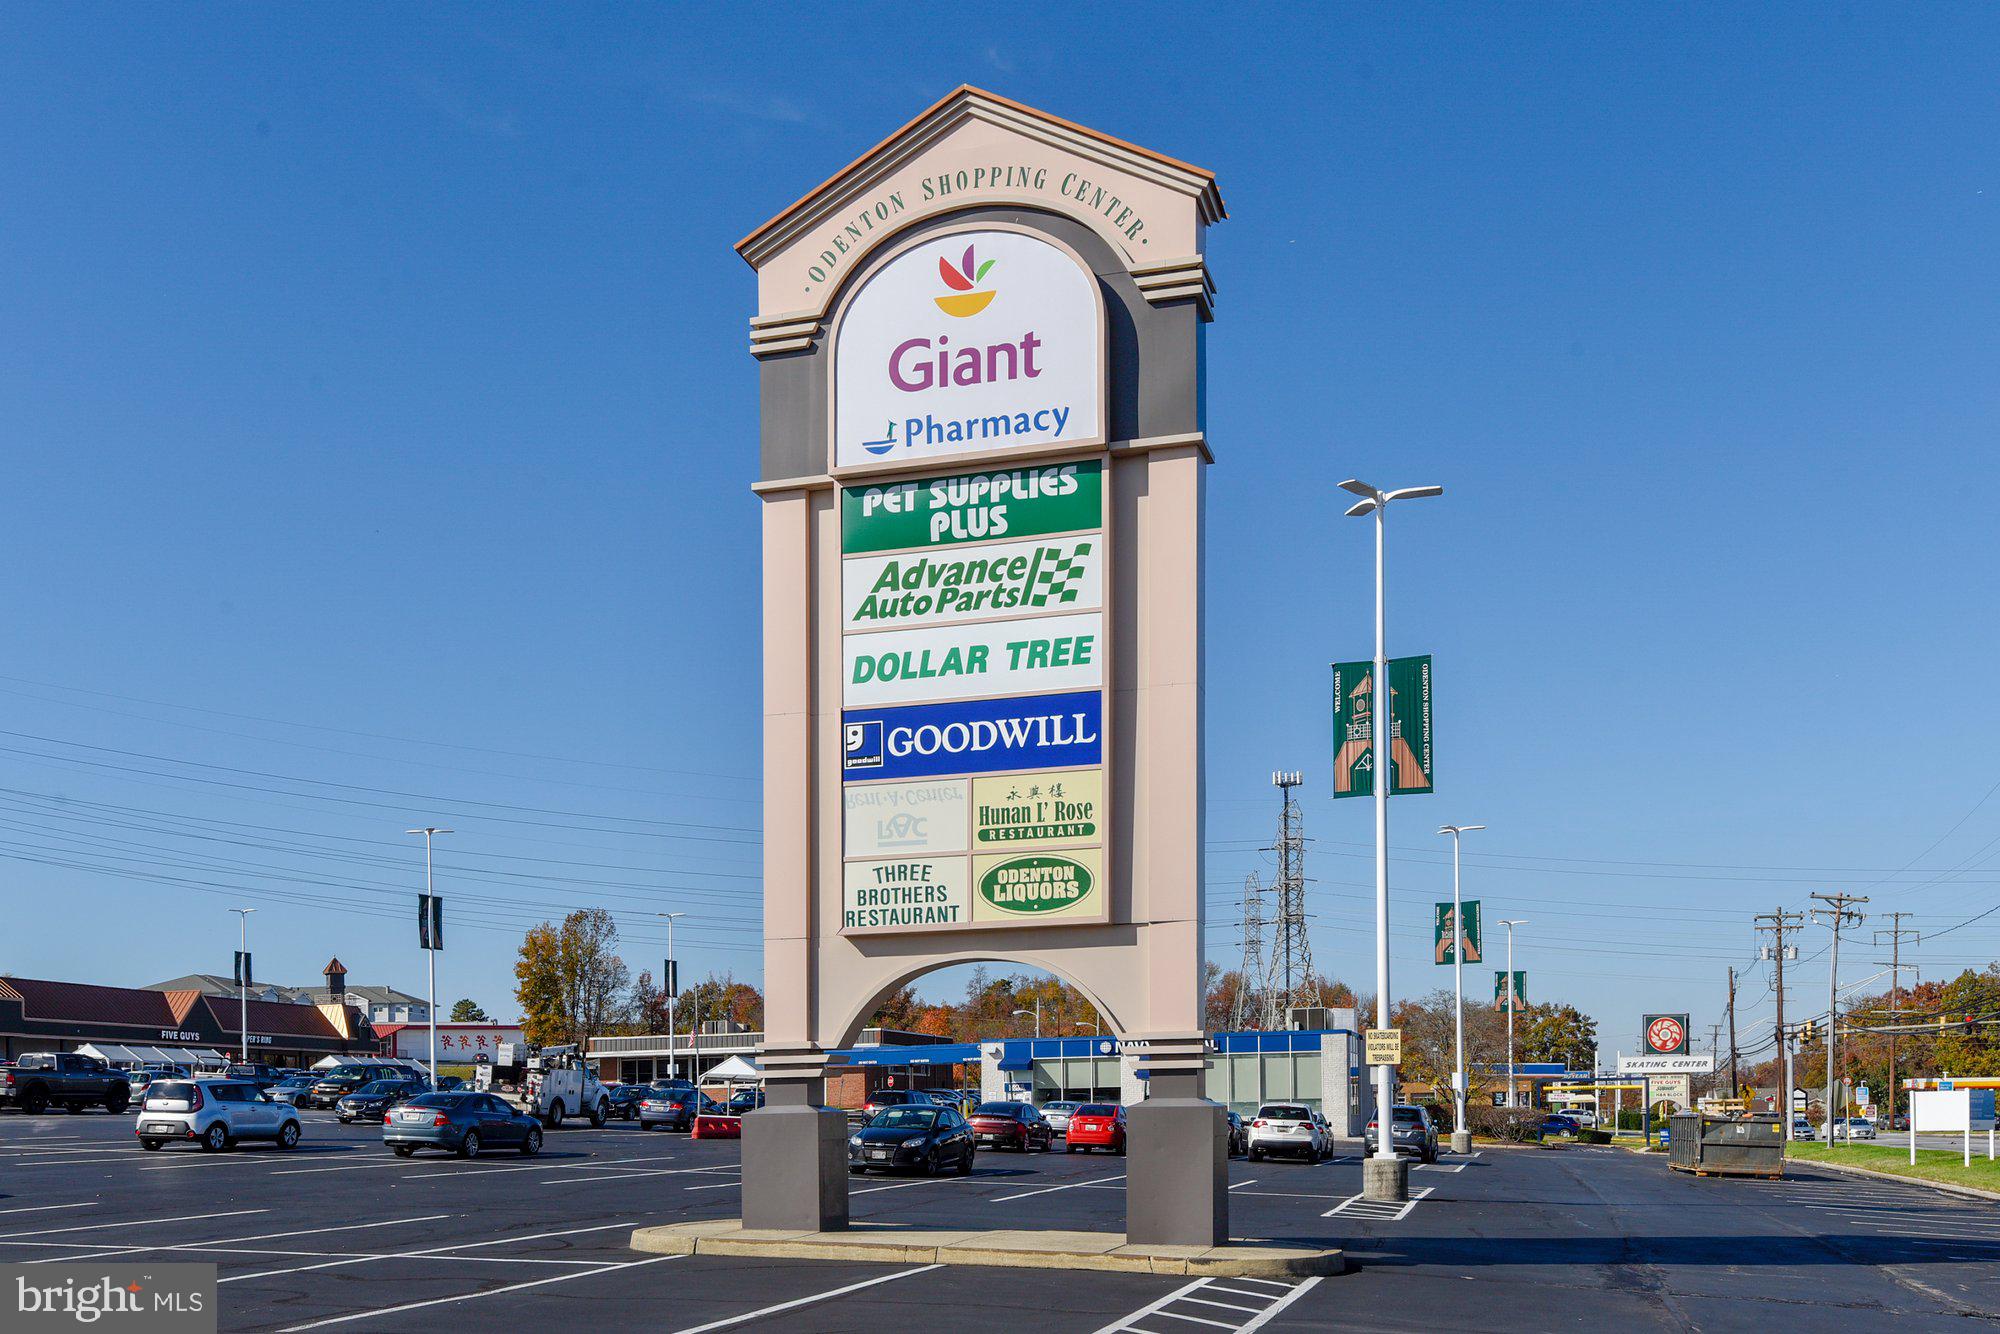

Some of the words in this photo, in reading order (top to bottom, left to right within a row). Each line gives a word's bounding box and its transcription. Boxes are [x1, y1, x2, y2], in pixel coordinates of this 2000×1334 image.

[808, 191, 905, 283] ODENTON
[921, 165, 1047, 201] SHOPPING
[1060, 172, 1146, 241] CENTER
[889, 331, 1042, 392] Giant
[905, 406, 1070, 447] Pharmacy
[863, 483, 918, 517] PET
[929, 465, 1079, 510] SUPPLIES
[930, 505, 1009, 542] PLUS
[870, 555, 1027, 594] Advance
[852, 644, 989, 685] DOLLAR
[1006, 635, 1095, 671] TREE
[887, 713, 1097, 757] GOODWILL
[847, 756, 881, 767] goodwill
[979, 805, 1031, 826] Hunan
[1055, 801, 1093, 822] Rose
[989, 824, 1085, 840] RESTAURANT
[872, 864, 932, 884] THREE
[997, 866, 1075, 884] ODENTON
[857, 885, 948, 906] BROTHERS
[993, 881, 1080, 903] LIQUORS
[846, 905, 960, 927] RESTAURANT
[161, 1030, 178, 1040] FIVE
[180, 1031, 200, 1041] GUYS
[1672, 1060, 1709, 1068] CENTER
